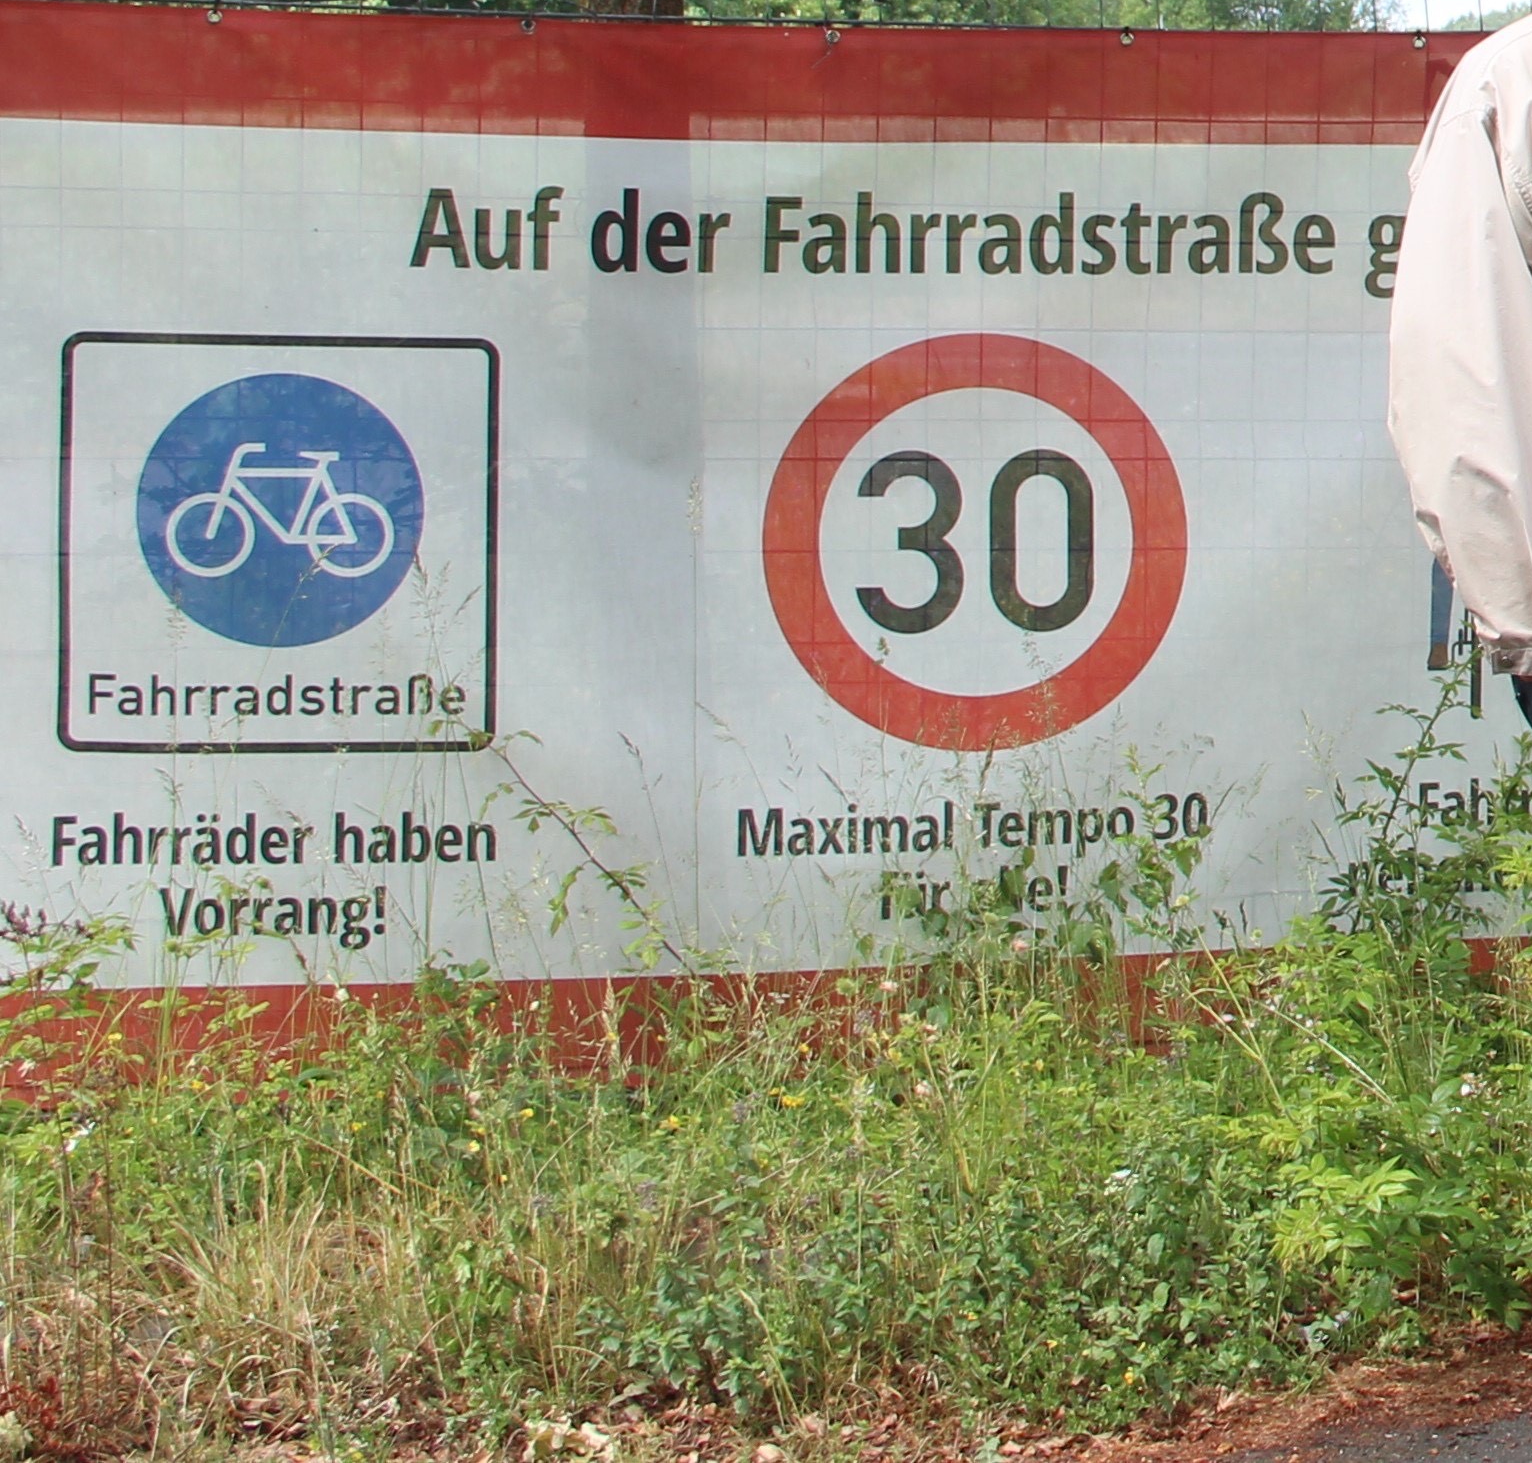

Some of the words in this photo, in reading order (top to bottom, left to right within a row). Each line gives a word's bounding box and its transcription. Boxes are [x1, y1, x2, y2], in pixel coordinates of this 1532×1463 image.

[410, 186, 563, 271] Auf
[590, 187, 731, 274] der
[764, 191, 1336, 276] Fahrradstraße
[1364, 215, 1406, 298] g
[856, 449, 1094, 634] 30
[88, 673, 468, 717] Fahrradstraße
[52, 813, 312, 867] Fahrräder
[334, 811, 497, 864] haben
[737, 801, 953, 857] Maximal
[974, 801, 1135, 858] Tempo
[1152, 791, 1210, 840] 30
[159, 885, 388, 951] Vorrang!
